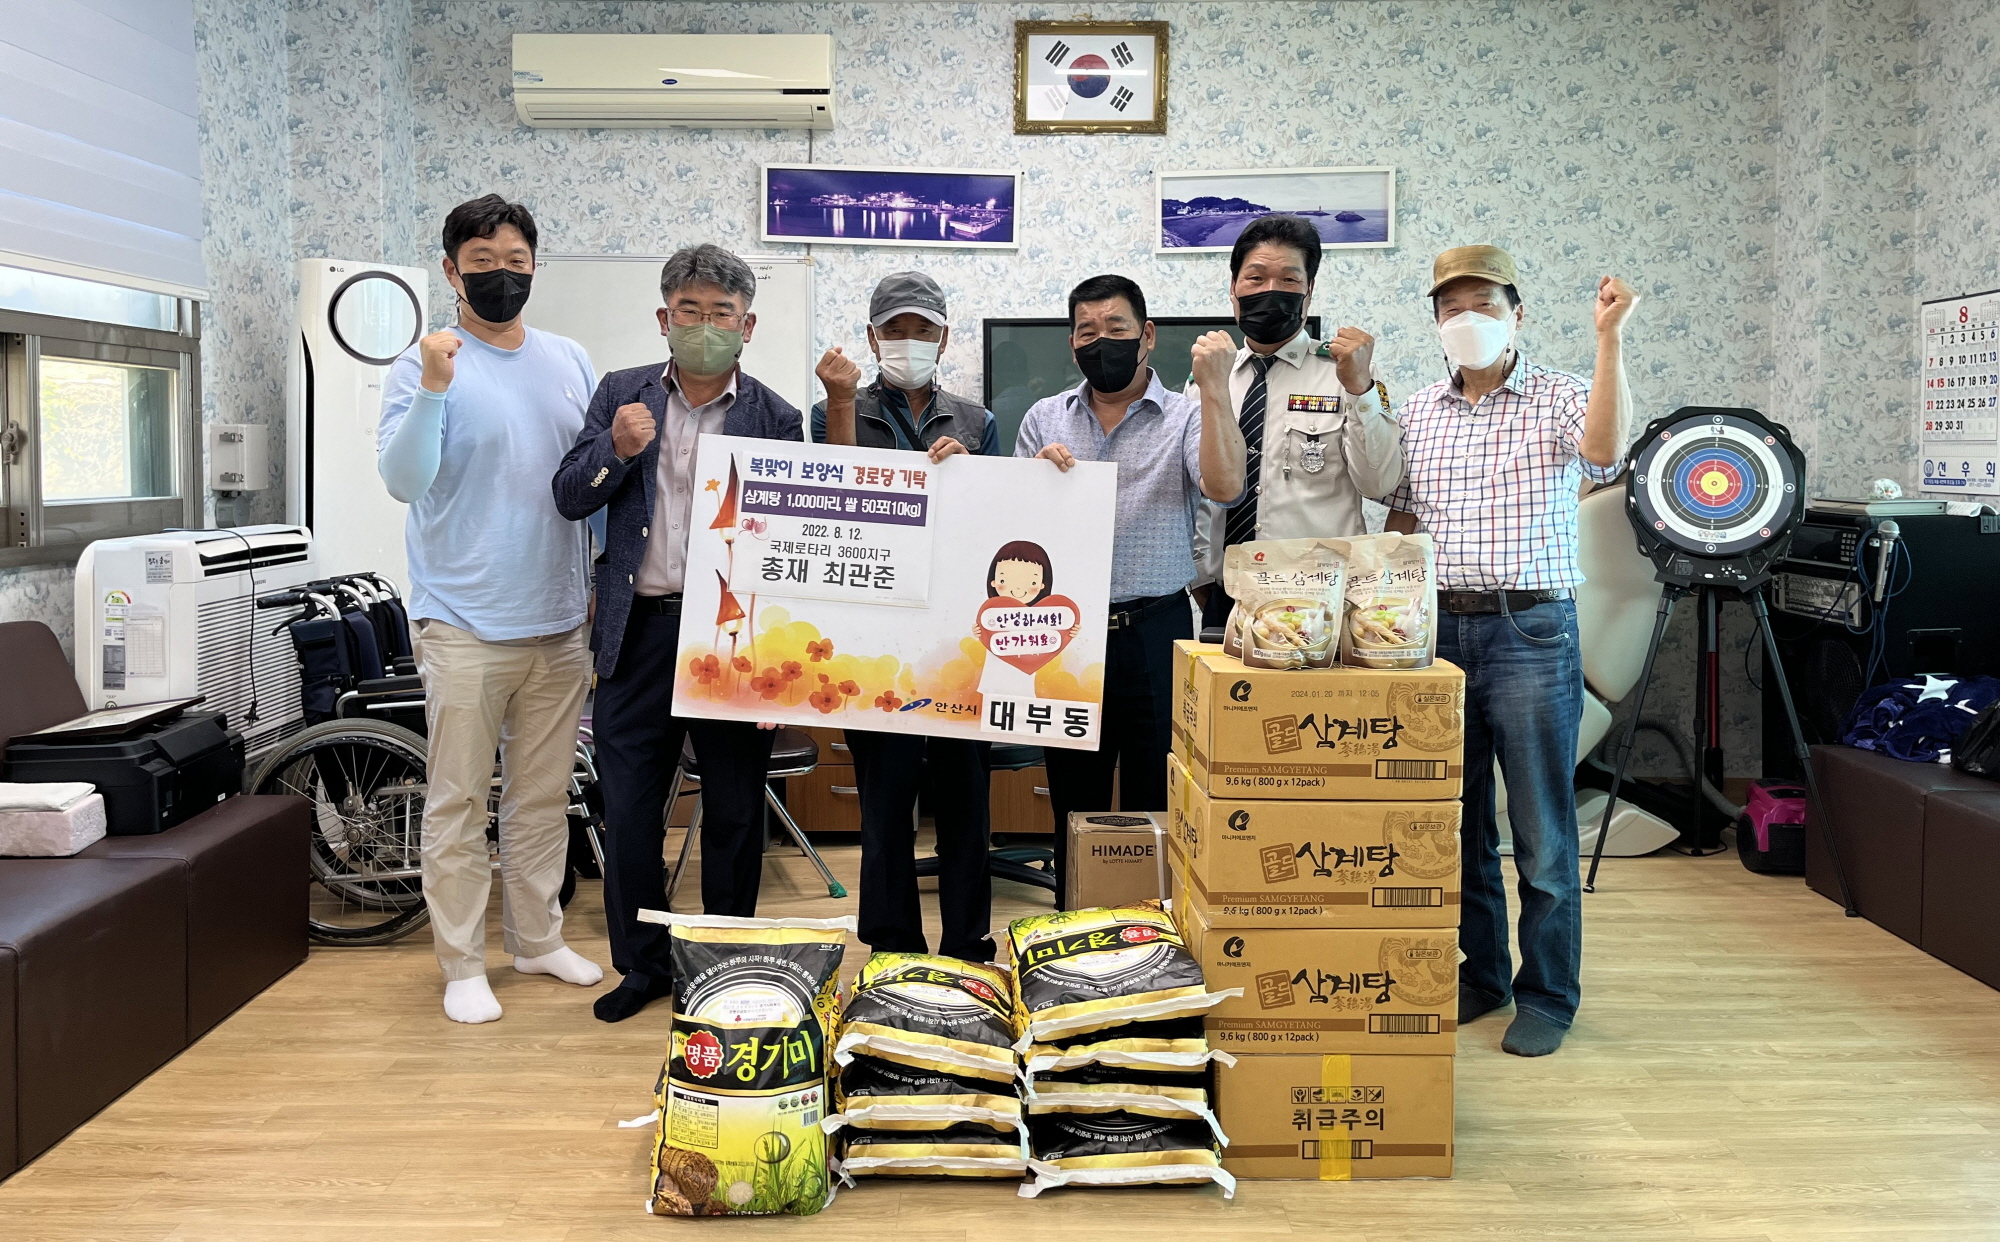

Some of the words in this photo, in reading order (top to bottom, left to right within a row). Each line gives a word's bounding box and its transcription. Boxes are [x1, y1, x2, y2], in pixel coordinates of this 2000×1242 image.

[1959, 306, 1968, 323] 8
[1941, 336, 1944, 345] 1
[1950, 335, 1954, 344] 2
[1961, 333, 1965, 342] 3
[1972, 332, 1975, 341] 4
[1981, 331, 1984, 340] 5
[1991, 330, 1995, 338] 6
[1929, 358, 1933, 367] 7
[1940, 357, 1943, 366] 8
[1950, 356, 1953, 365] 9
[1959, 355, 1966, 364] 10
[1970, 354, 1976, 363] 11
[1980, 353, 1986, 363] 12
[1990, 352, 1996, 361] 13
[1927, 379, 1934, 388] 14
[1937, 378, 1944, 387] 15
[1948, 378, 1954, 387] 16
[1958, 377, 1965, 386] 17
[1969, 376, 1976, 386] 18
[1980, 376, 1986, 385] 19
[1990, 375, 1997, 384] 20
[1927, 401, 1933, 410] 21
[1936, 401, 1943, 409] 22
[1946, 400, 1954, 409] 23
[1957, 399, 1965, 408] 24
[1968, 398, 1975, 407] 25
[1978, 398, 1985, 407] 26
[1989, 397, 1996, 407] 27
[1926, 422, 1933, 430] 28
[1935, 421, 1943, 430] 29
[1945, 421, 1953, 430] 30
[1956, 421, 1963, 430] 31
[750, 458, 792, 478] 복맞이
[801, 462, 843, 483] 보양식
[852, 466, 895, 487] 경로당
[900, 469, 927, 489] 기탁
[744, 489, 781, 506] 삼계탕
[786, 493, 841, 512] 1,000마리,
[845, 497, 857, 512] 쌀
[862, 499, 921, 517] 50포(10kg)
[802, 524, 829, 537] 2022.
[834, 528, 843, 538] 8.
[849, 528, 862, 540] 12.
[770, 540, 831, 557] 국제로타리
[838, 546, 891, 561] 3600지구
[761, 557, 809, 583] 총재
[823, 561, 895, 589] 최관준
[1253, 572, 1288, 585] 골드
[1291, 570, 1338, 586] 삼계탕
[1347, 574, 1378, 588] 골드
[1381, 567, 1427, 584] 삼계탕
[997, 612, 1061, 628] 안녕하세요!
[1291, 690, 1333, 698] 2024.01.20
[935, 702, 978, 716] 안산시
[990, 700, 1089, 738] 대부동
[1265, 723, 1299, 748] 골드
[1299, 713, 1404, 750] 삼계탕
[1224, 764, 1260, 774] Premium
[1262, 765, 1327, 774] SAMGYETANG
[1226, 777, 1239, 786] 9.6
[1241, 777, 1251, 786] kg
[1092, 845, 1154, 856] HIMADE
[1263, 852, 1297, 877] 골드
[1296, 842, 1400, 878] 삼계탕
[1222, 894, 1257, 903] Premium
[1259, 894, 1325, 903] SAMGYETANG
[1224, 907, 1236, 915] 9.6
[1239, 906, 1249, 917] kg
[1026, 931, 1117, 964] 경기미
[730, 956, 747, 966] 하루의
[748, 955, 762, 963] 시작!
[763, 955, 775, 963] 하루
[1259, 979, 1293, 1004] 골드
[1292, 968, 1396, 1004] 삼계탕
[1218, 1020, 1253, 1029] Premium
[1255, 1021, 1321, 1029] SAMGYETANG
[1220, 1032, 1233, 1041] 9.6
[1236, 1032, 1246, 1043] kg
[687, 1044, 720, 1067] 명품
[726, 1030, 816, 1082] 경기미
[1291, 1108, 1384, 1131] 취급주의
[1120, 1134, 1134, 1143] 시작!
